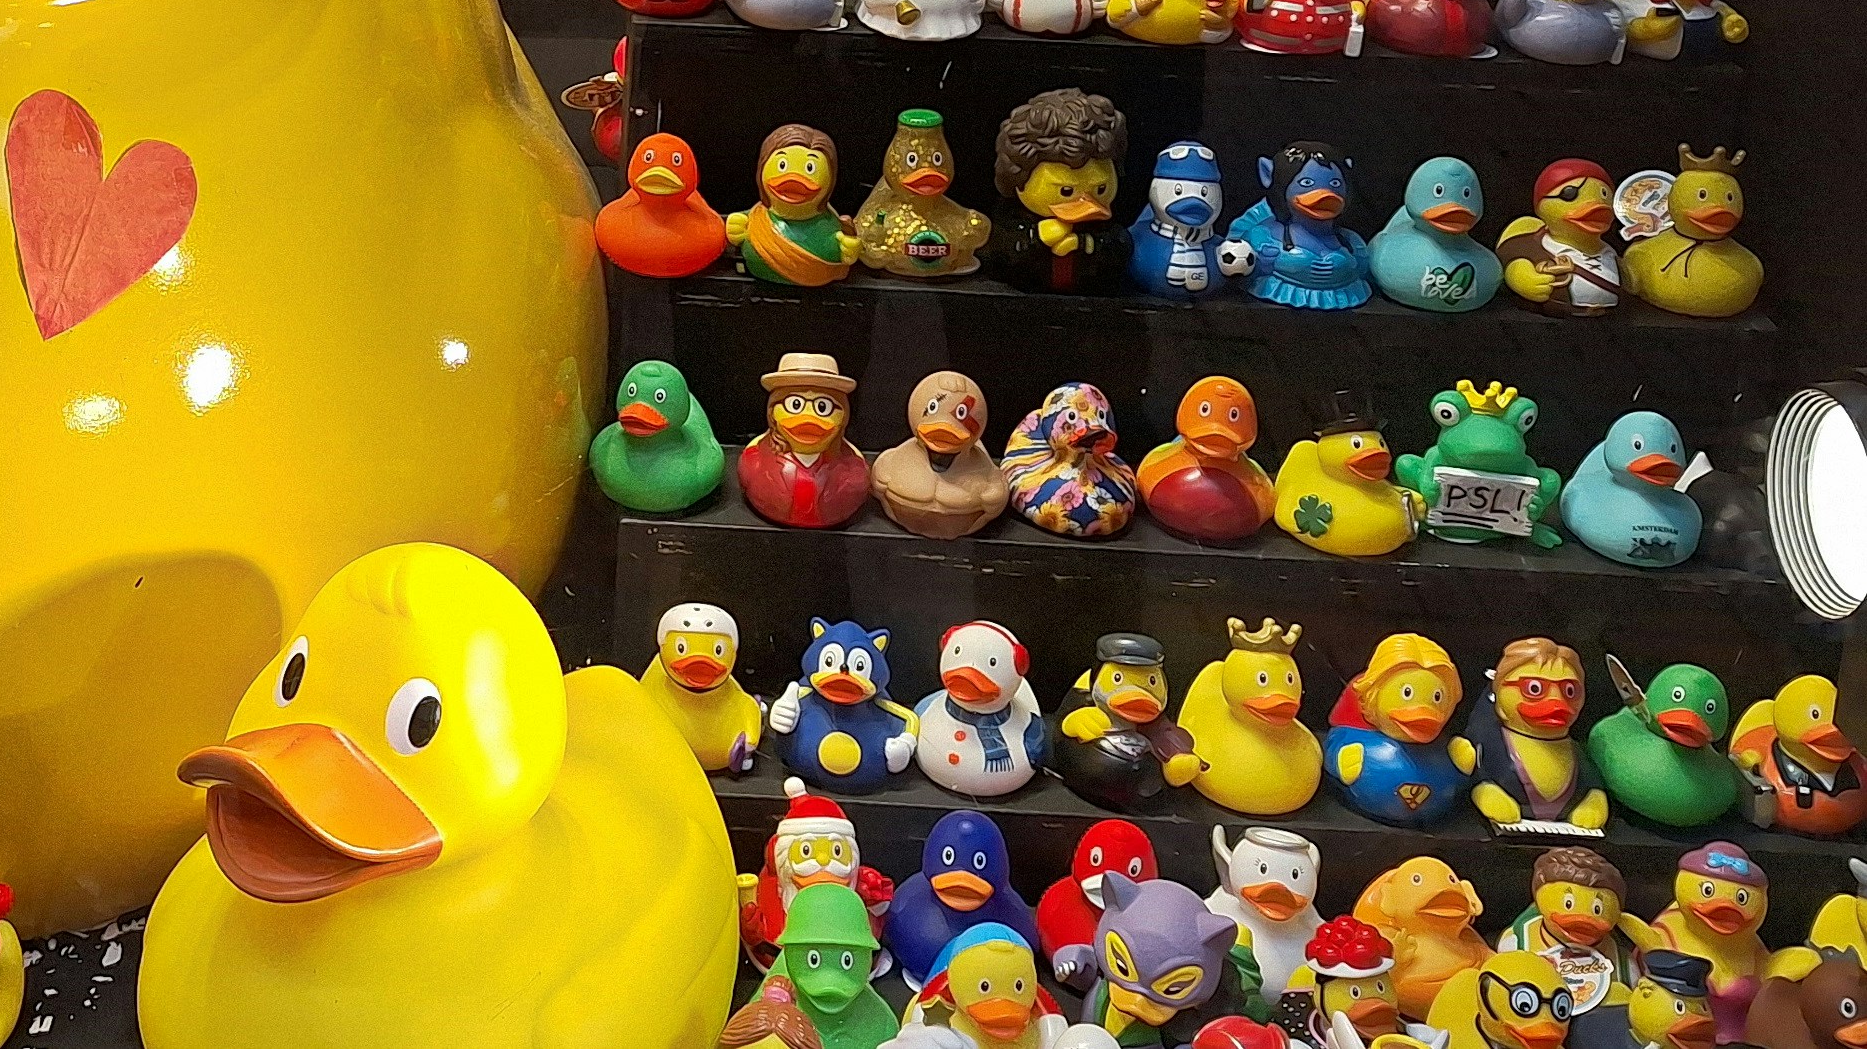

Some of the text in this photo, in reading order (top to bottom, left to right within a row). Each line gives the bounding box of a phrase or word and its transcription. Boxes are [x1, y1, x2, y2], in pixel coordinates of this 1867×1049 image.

[907, 244, 948, 257] BEER
[1190, 272, 1205, 281] GE
[1420, 265, 1451, 289] be
[1446, 485, 1526, 523] PSL!
[1559, 960, 1609, 976] Ducks
